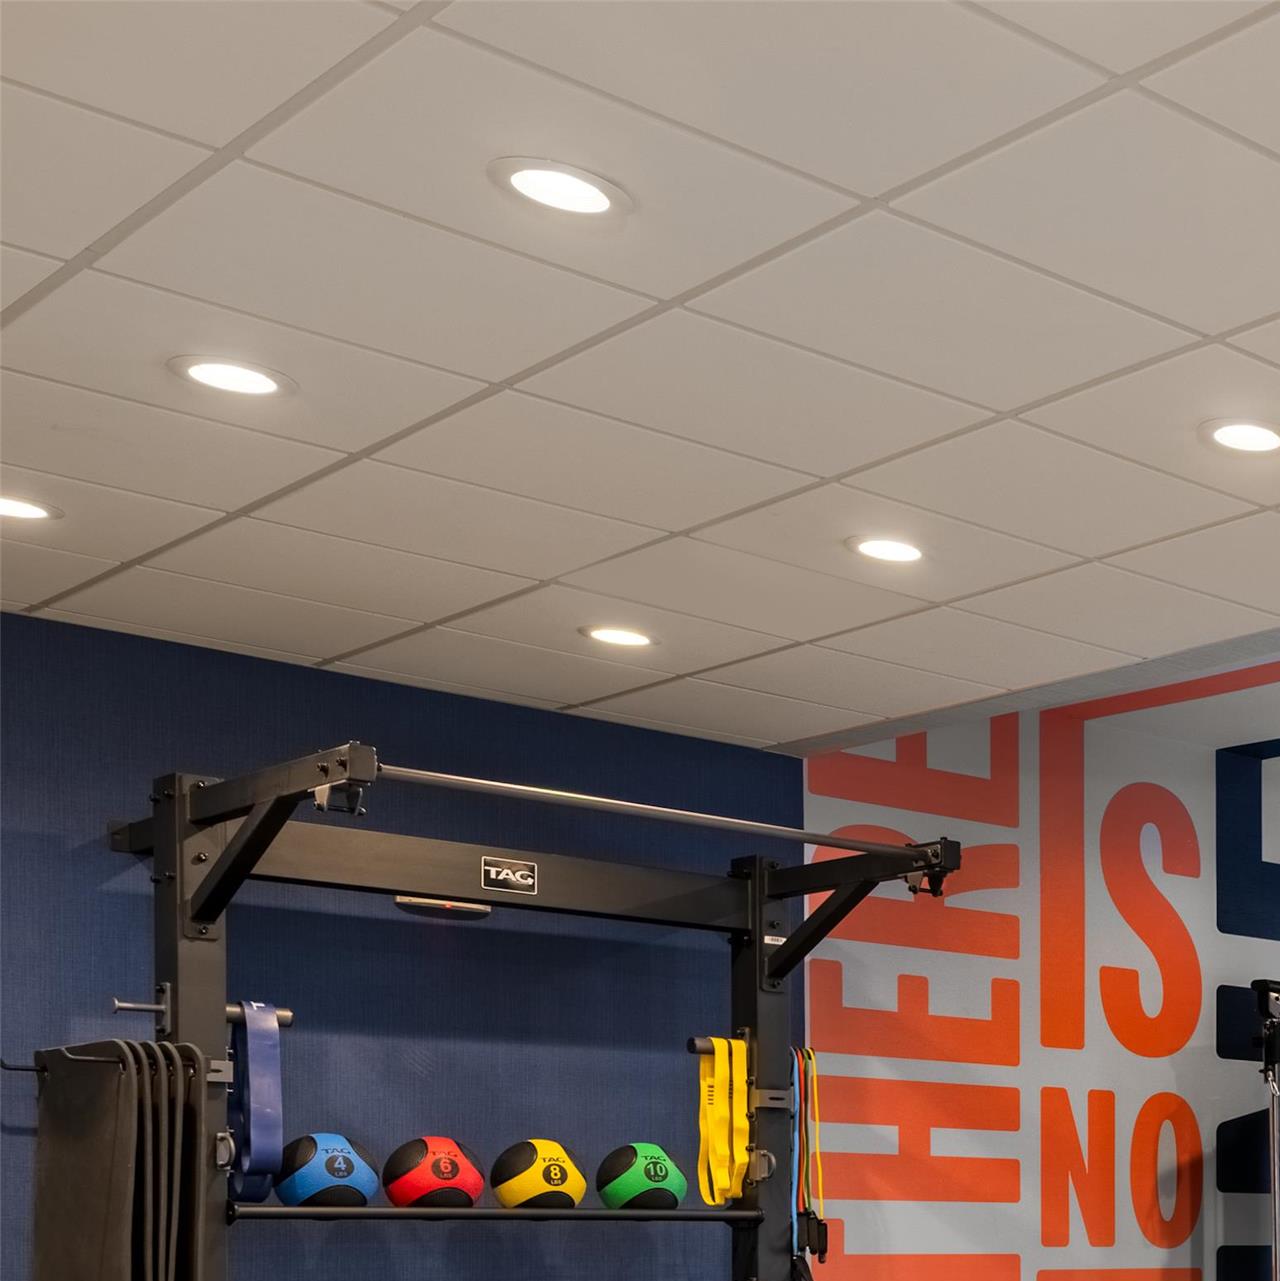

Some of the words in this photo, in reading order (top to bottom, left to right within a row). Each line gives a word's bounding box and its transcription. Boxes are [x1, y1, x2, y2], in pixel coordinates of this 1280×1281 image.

[484, 866, 535, 885] TAG
[1039, 709, 1202, 1058] IS
[334, 1157, 347, 1170] 4
[440, 1159, 452, 1173] 6
[647, 1163, 666, 1176] 10
[1040, 1087, 1202, 1249] NO
[550, 1165, 561, 1179] 8
